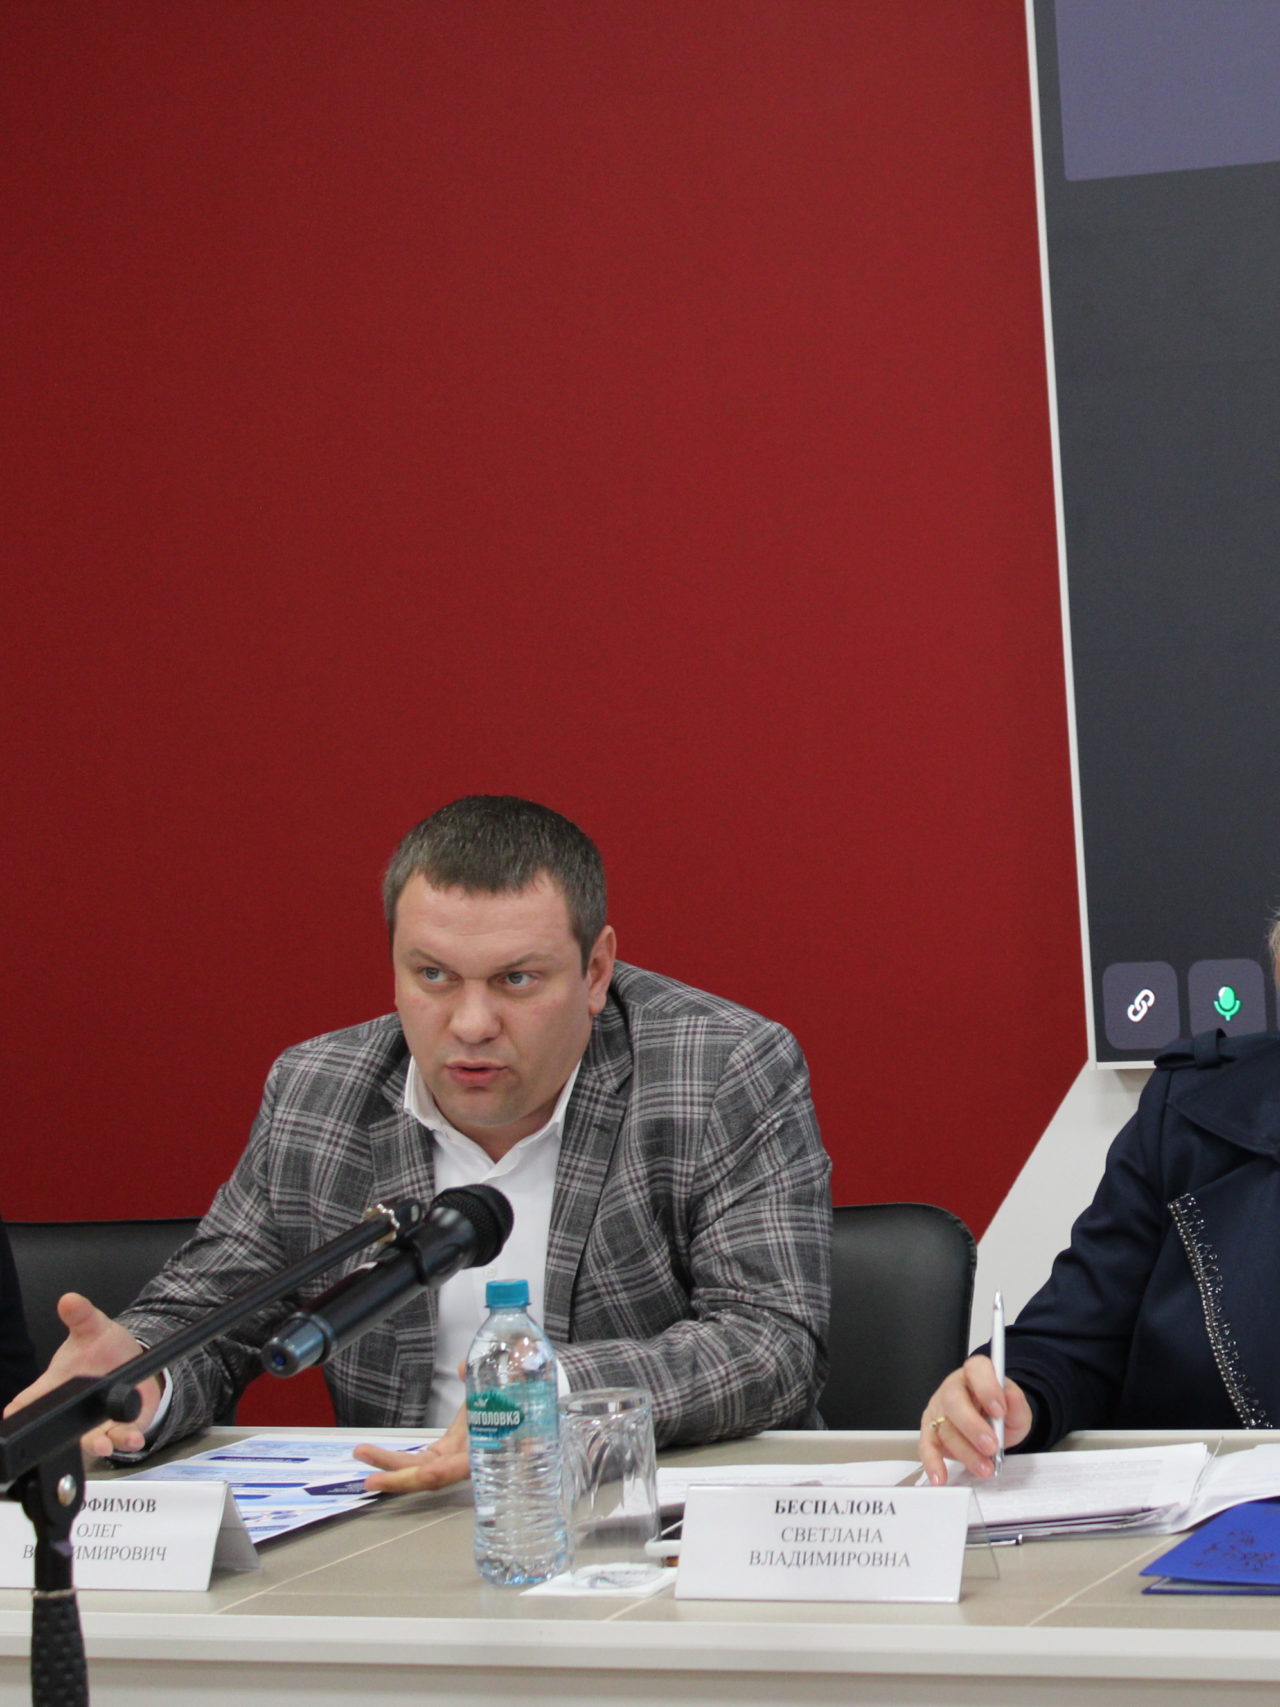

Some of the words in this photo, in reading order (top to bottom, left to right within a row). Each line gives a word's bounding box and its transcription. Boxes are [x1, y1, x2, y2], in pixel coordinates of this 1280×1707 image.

[774, 1499, 897, 1515] БЕСПАЛОВА
[76, 1522, 122, 1539] ОЛЕГ
[780, 1526, 884, 1544] СВЕТЛАНА
[749, 1550, 911, 1568] ВЛАДИМИРОВНА
